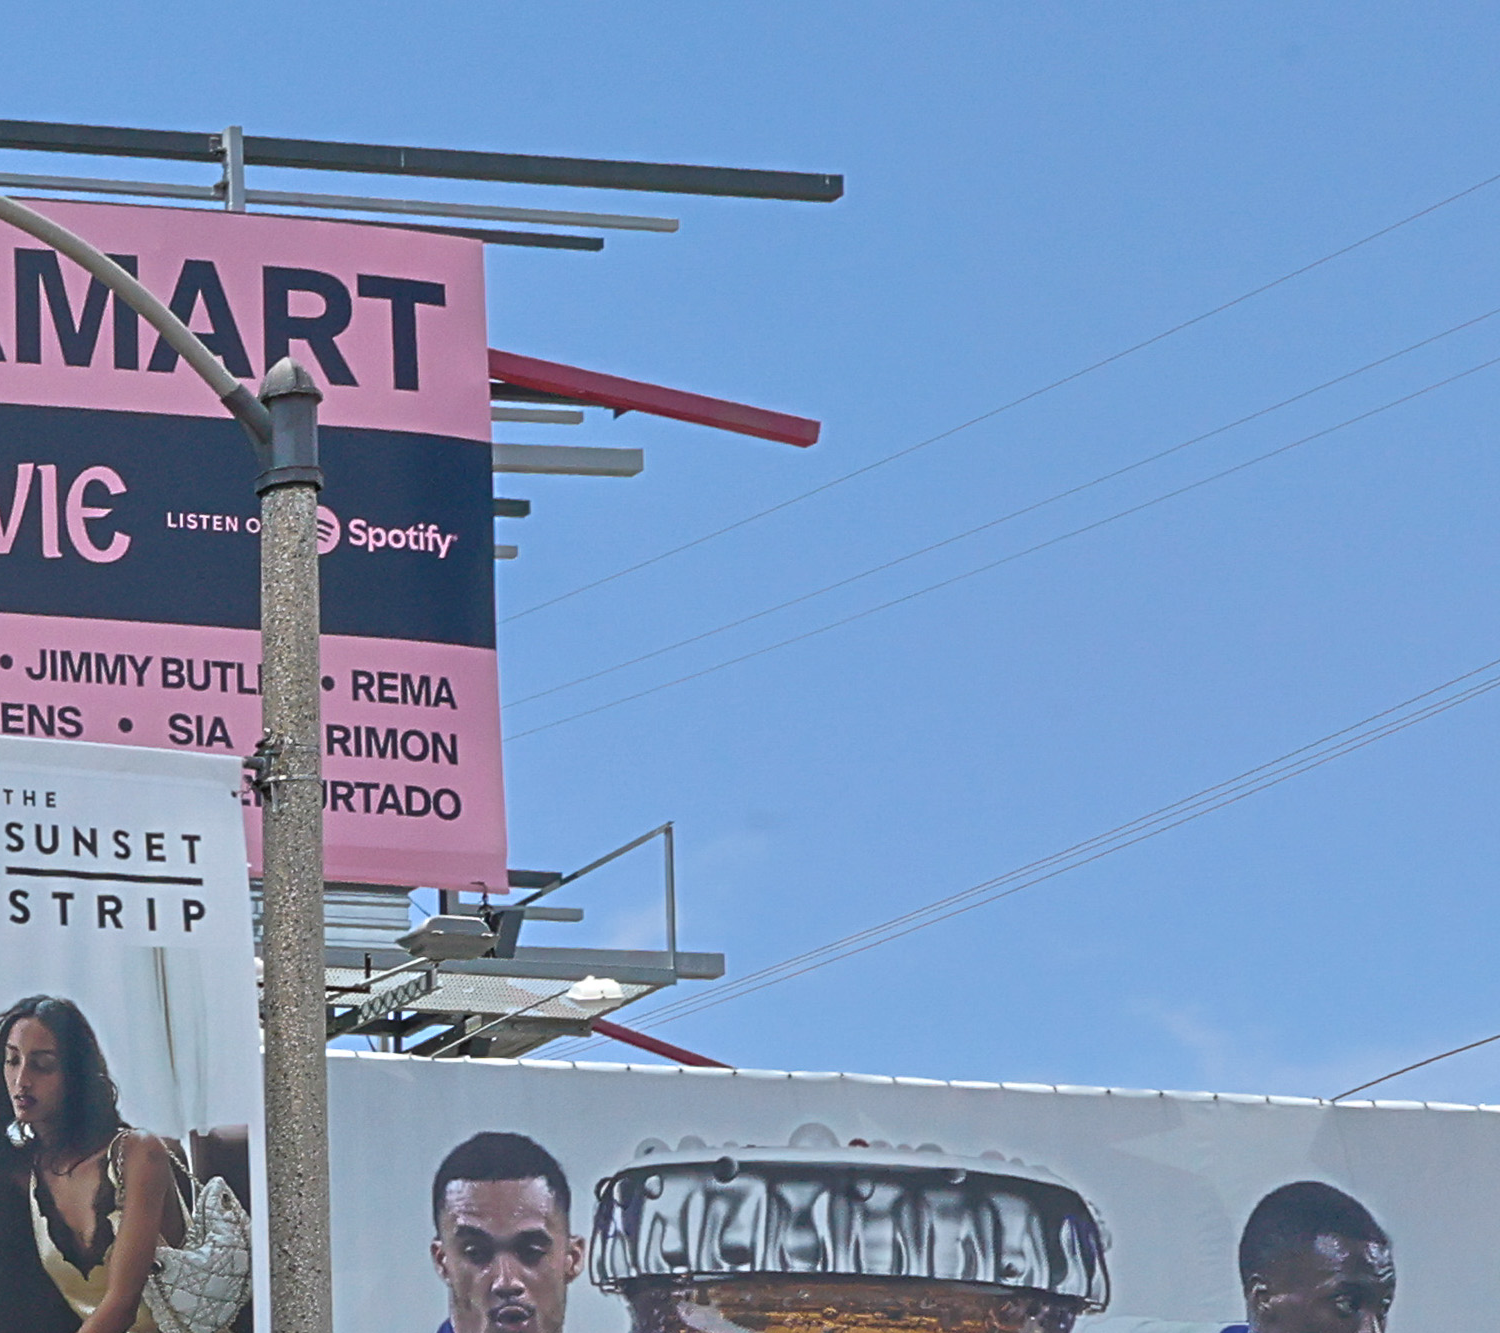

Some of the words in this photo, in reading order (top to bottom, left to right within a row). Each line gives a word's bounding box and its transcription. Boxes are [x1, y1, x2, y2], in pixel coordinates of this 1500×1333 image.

[167, 511, 239, 533] LISTEN
[245, 517, 261, 534] O
[348, 518, 454, 559] Spotify
[25, 648, 154, 689] JIMMY
[351, 670, 458, 711] REMA
[168, 712, 234, 749] SIA
[326, 725, 459, 766] RIMON
[3, 788, 57, 809] THE
[5, 821, 202, 865] SUNSET
[8, 889, 206, 933] STRIP
